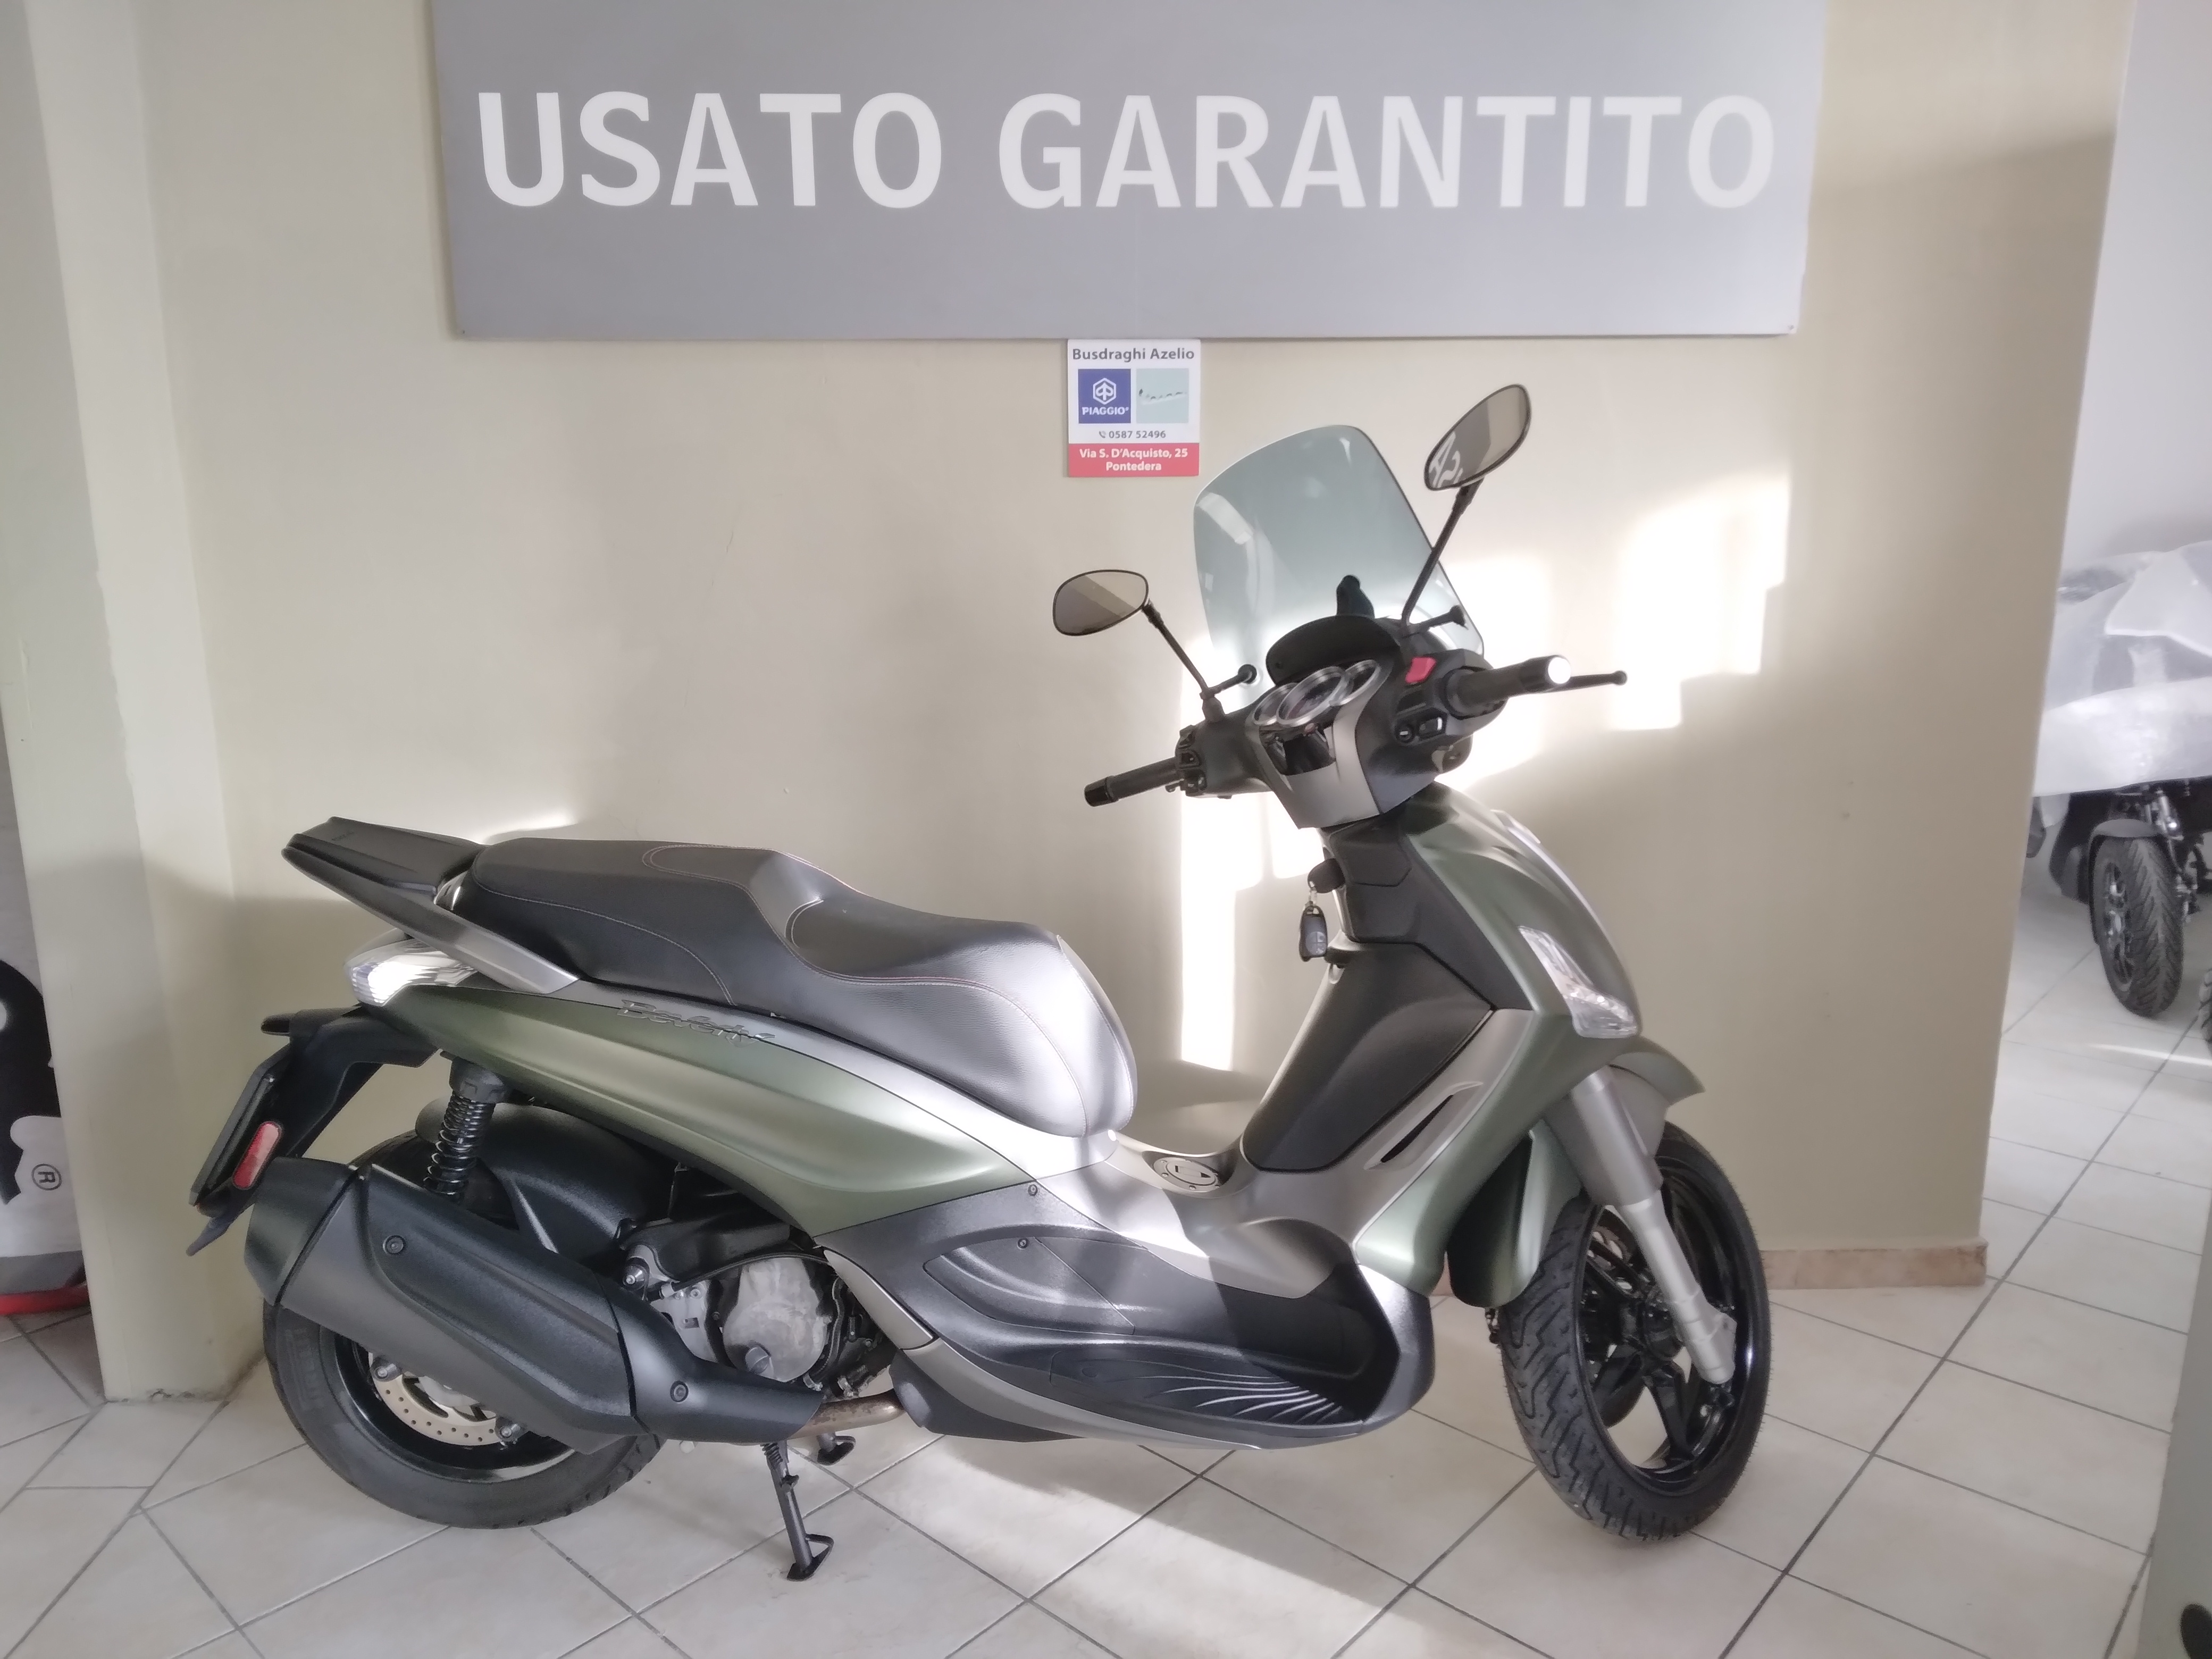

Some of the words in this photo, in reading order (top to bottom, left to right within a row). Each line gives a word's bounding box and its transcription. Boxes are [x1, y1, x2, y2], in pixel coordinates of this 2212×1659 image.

[478, 91, 942, 208] USATO
[999, 93, 1774, 209] GARANTITO
[1072, 348, 1146, 363] Busdraghi
[1150, 347, 1195, 359] Azelio
[1136, 430, 1166, 439] 52496
[1079, 448, 1096, 458] Via
[1099, 449, 1109, 458] S.
[1111, 448, 1172, 459] D'Acquisto,
[1174, 448, 1188, 458] 25
[1105, 461, 1162, 471] Pontedera
